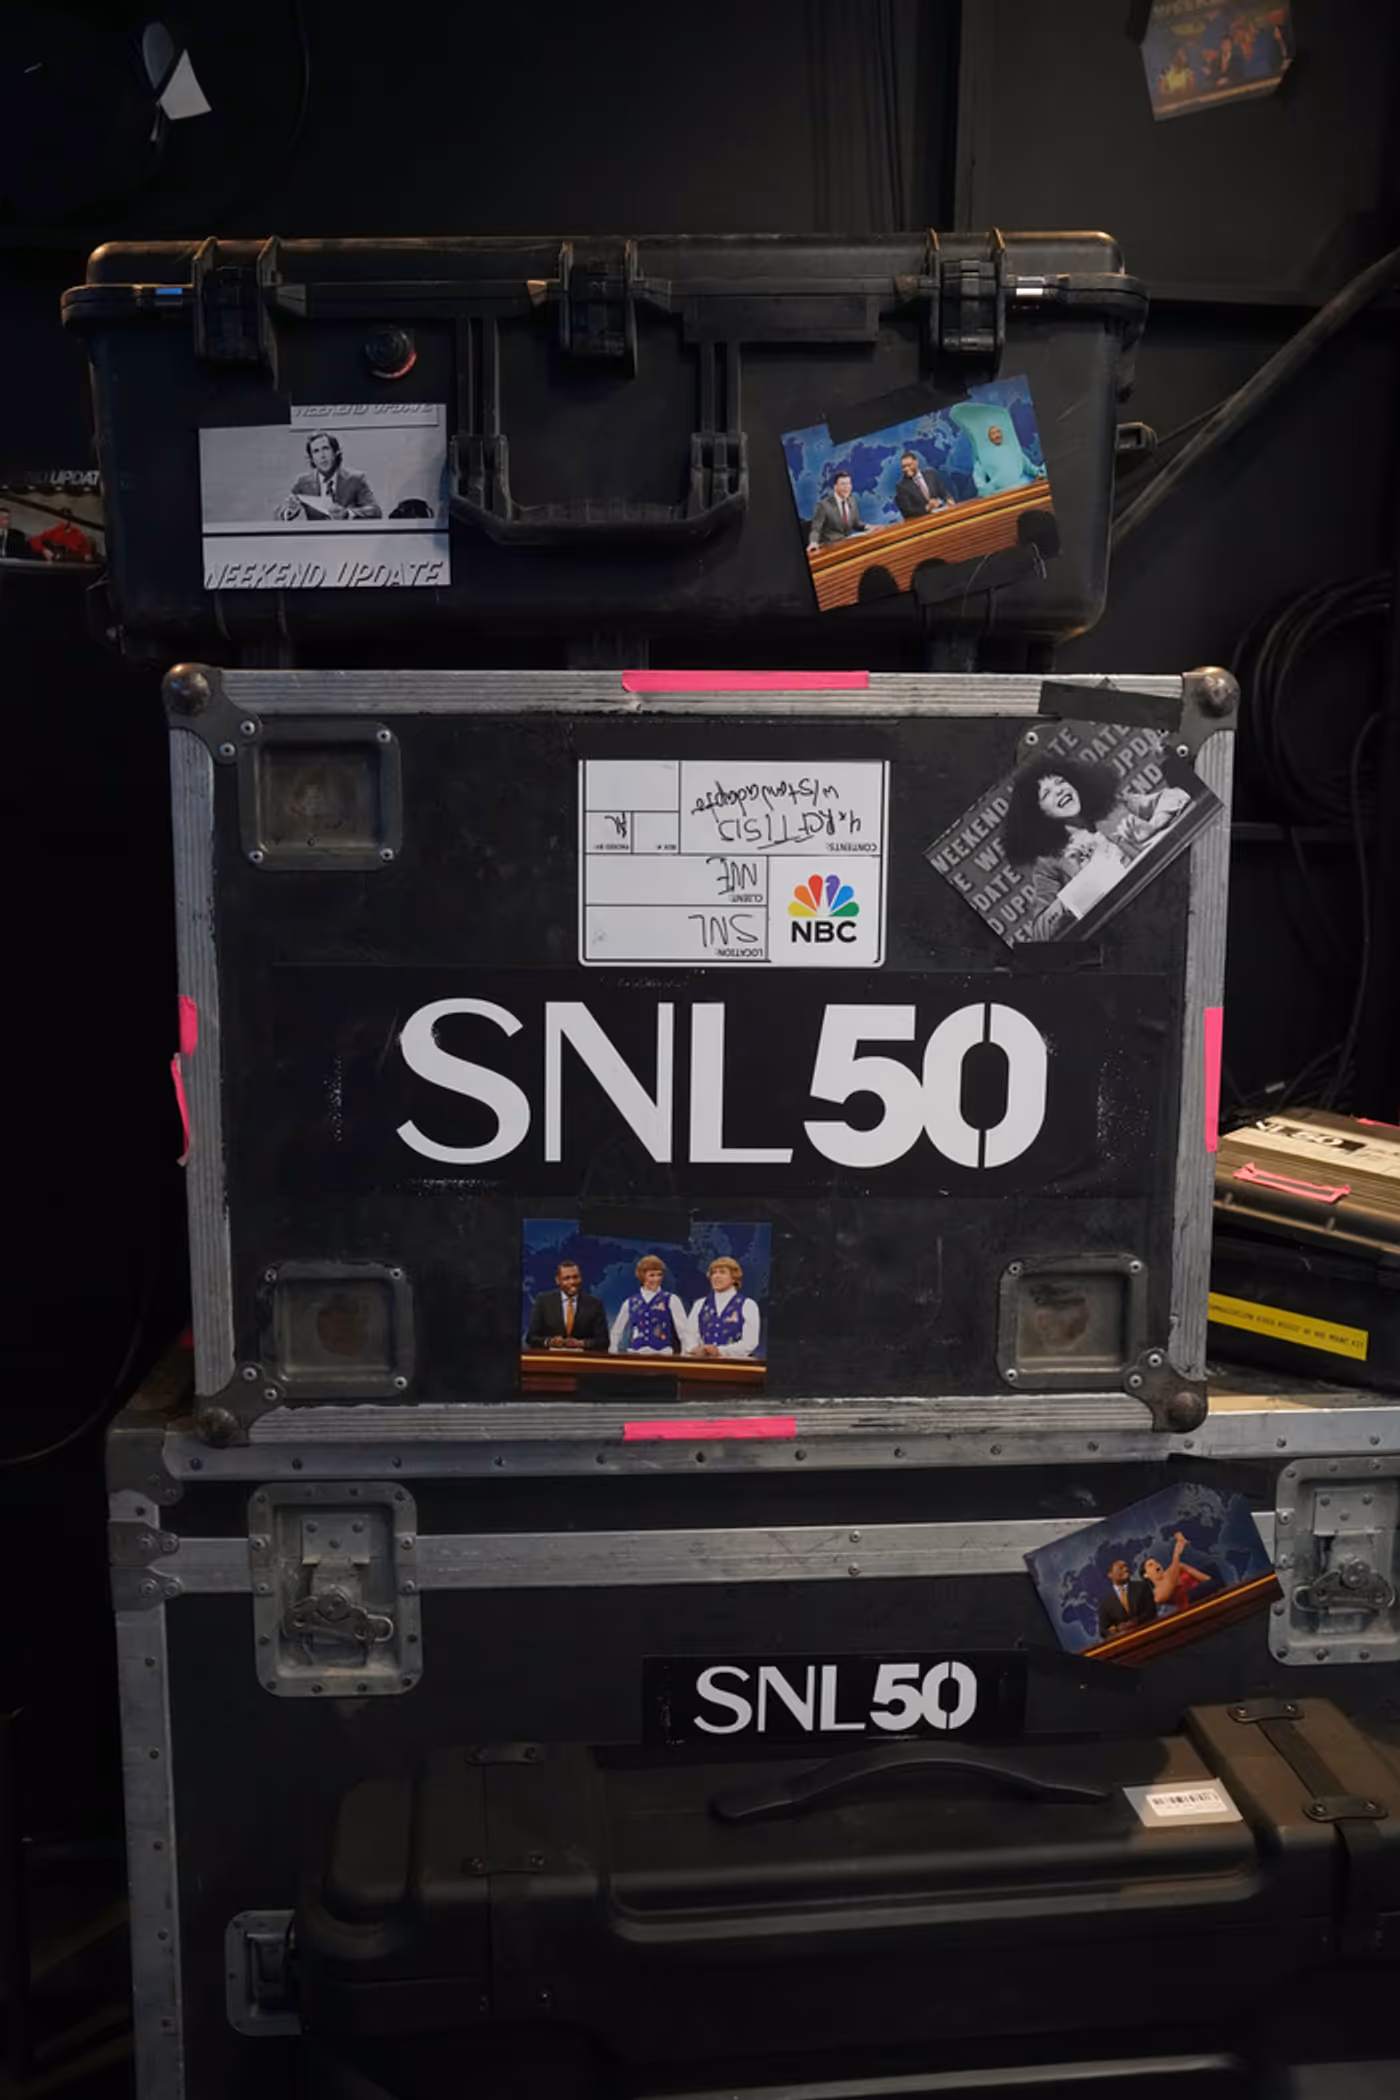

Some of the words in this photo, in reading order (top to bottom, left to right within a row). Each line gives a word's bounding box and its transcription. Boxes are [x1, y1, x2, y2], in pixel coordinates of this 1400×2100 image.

[337, 560, 444, 590] UPDATE
[687, 913, 760, 948] SNL
[791, 920, 858, 944] NBC
[715, 947, 764, 958] LOCATION:
